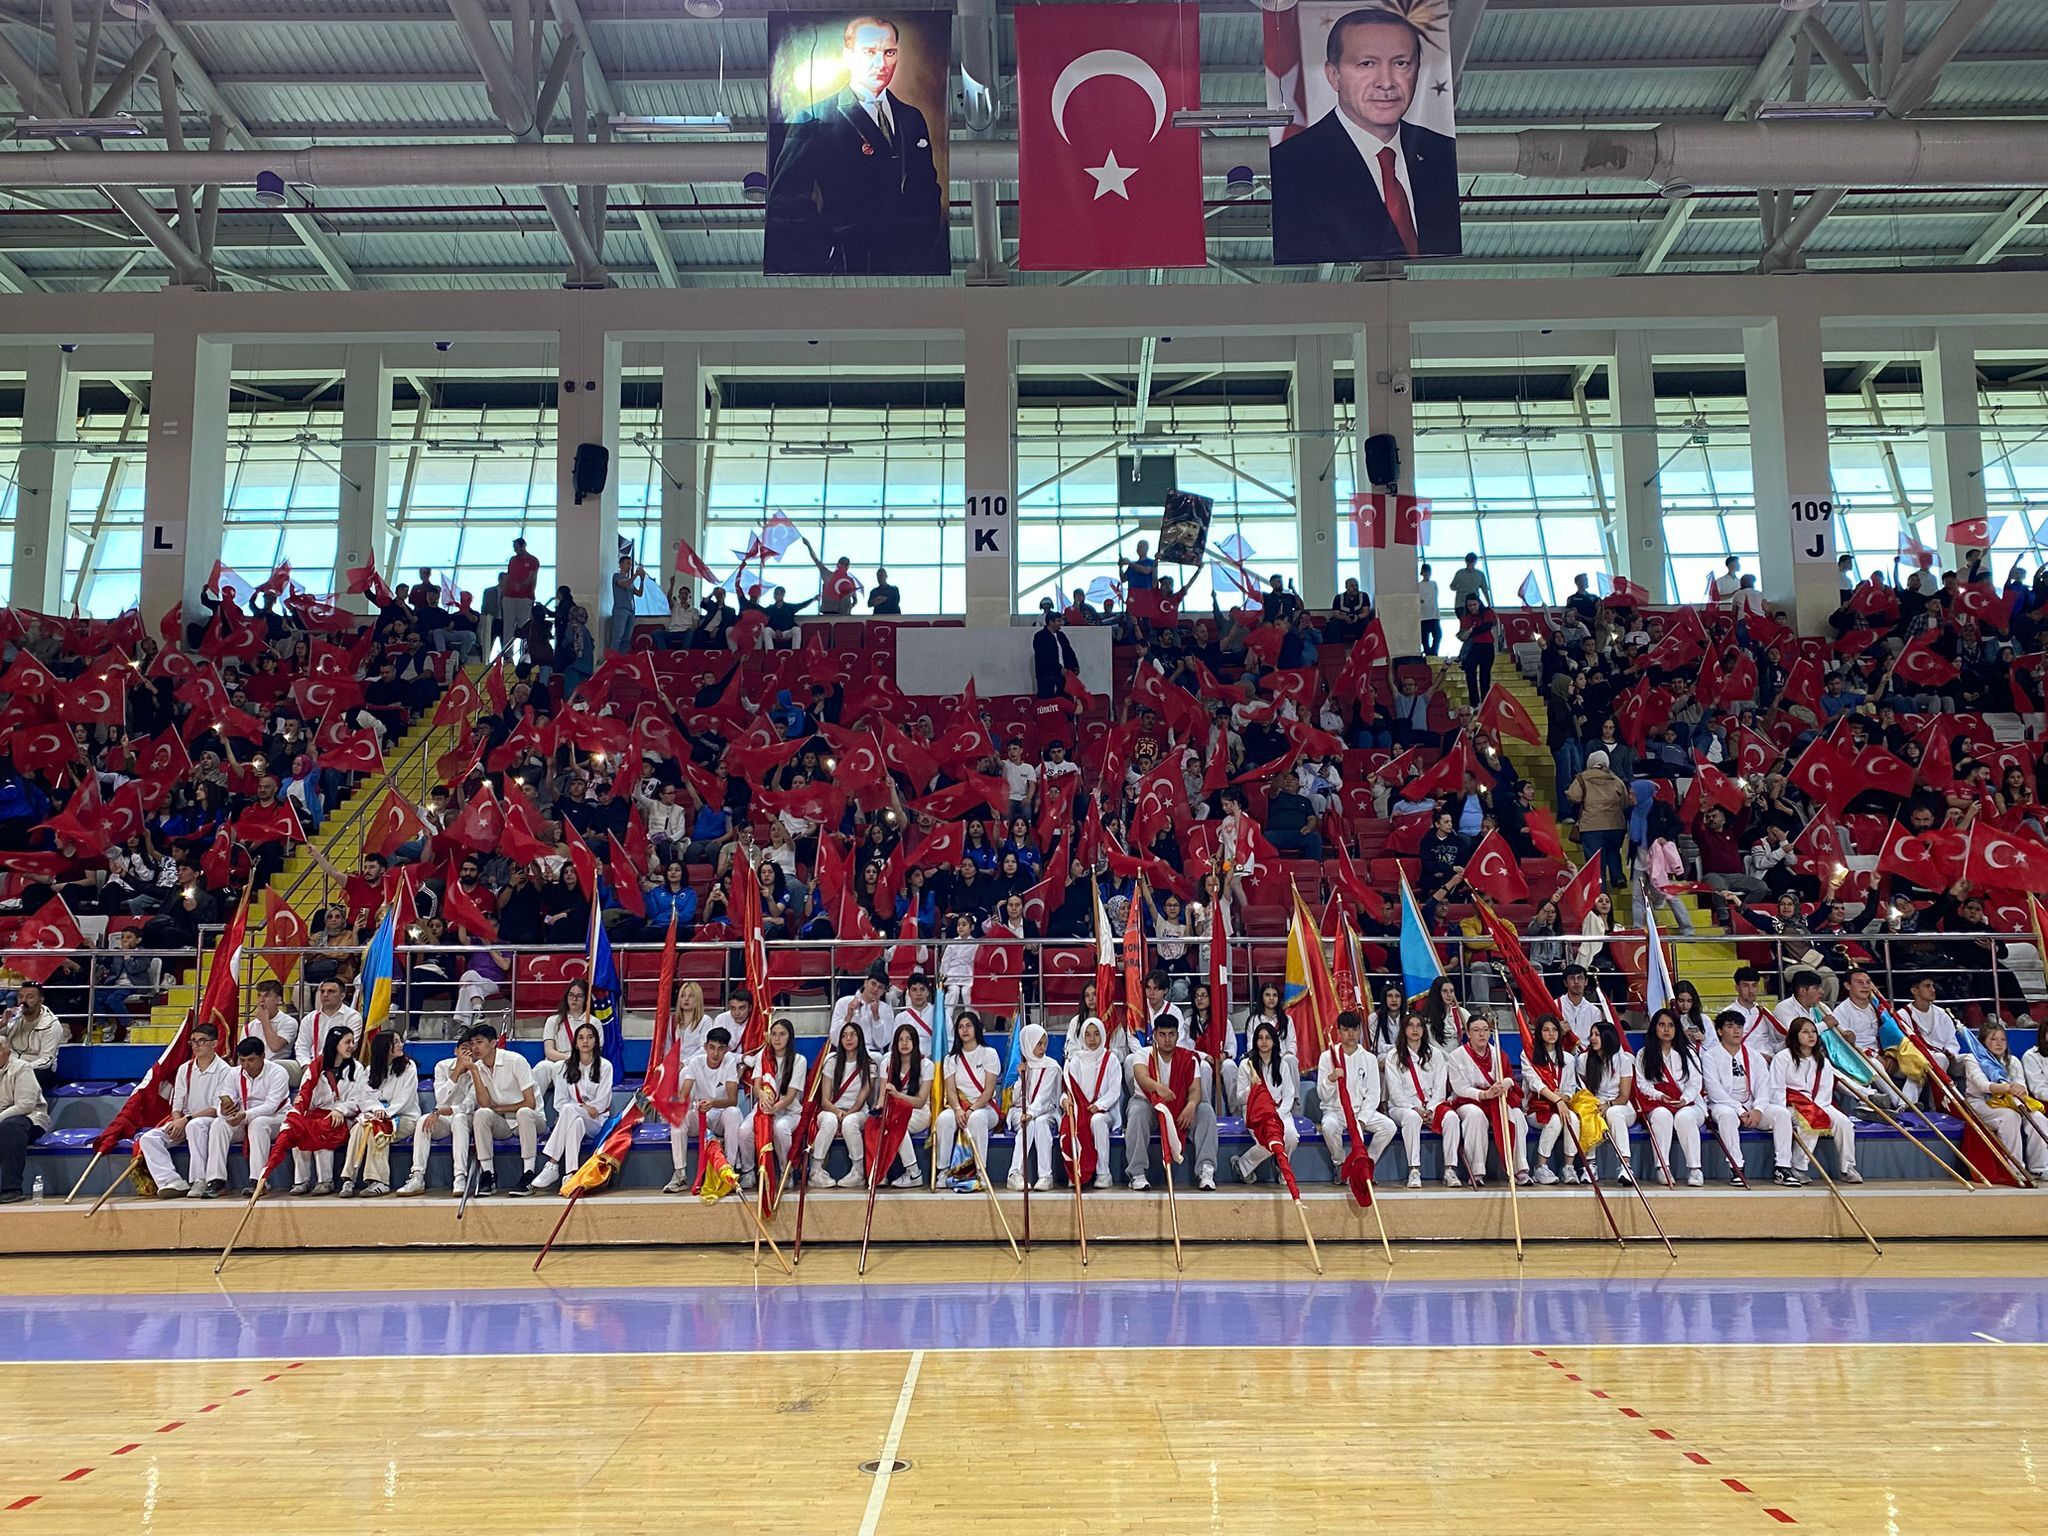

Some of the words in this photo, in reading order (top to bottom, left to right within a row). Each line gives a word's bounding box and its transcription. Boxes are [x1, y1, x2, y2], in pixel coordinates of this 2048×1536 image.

[967, 496, 1007, 516] 110
[1791, 501, 1832, 521] 109
[153, 526, 173, 549] L
[975, 529, 1000, 551] K
[1805, 534, 1825, 558] J
[1139, 743, 1154, 755] 25
